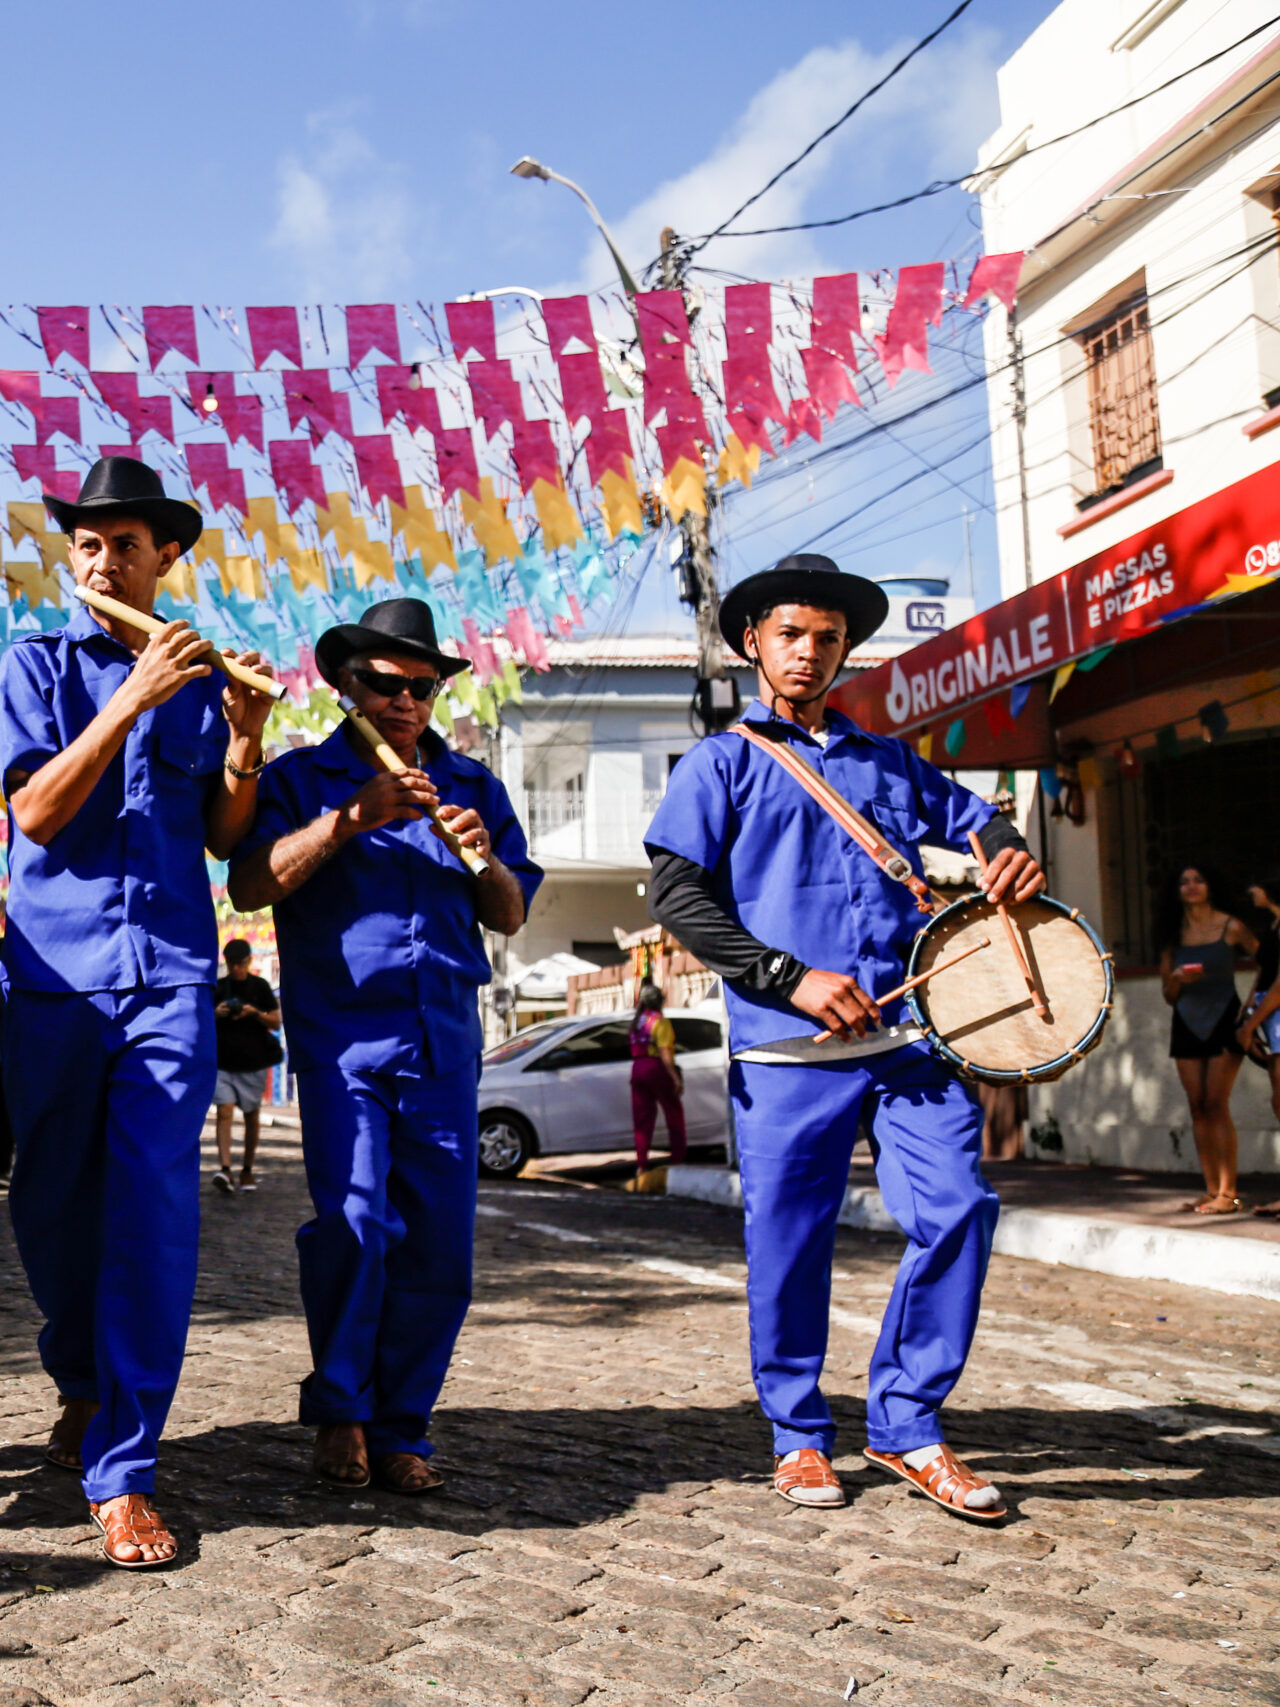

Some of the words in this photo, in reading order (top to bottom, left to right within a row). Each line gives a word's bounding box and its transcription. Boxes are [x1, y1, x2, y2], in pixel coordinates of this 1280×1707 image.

[1085, 543, 1167, 601] MASSAS
[1267, 541, 1280, 566] 8
[1087, 607, 1102, 629] E
[1104, 571, 1174, 620] PIZZAS
[886, 614, 1054, 724] ORIGINALE
